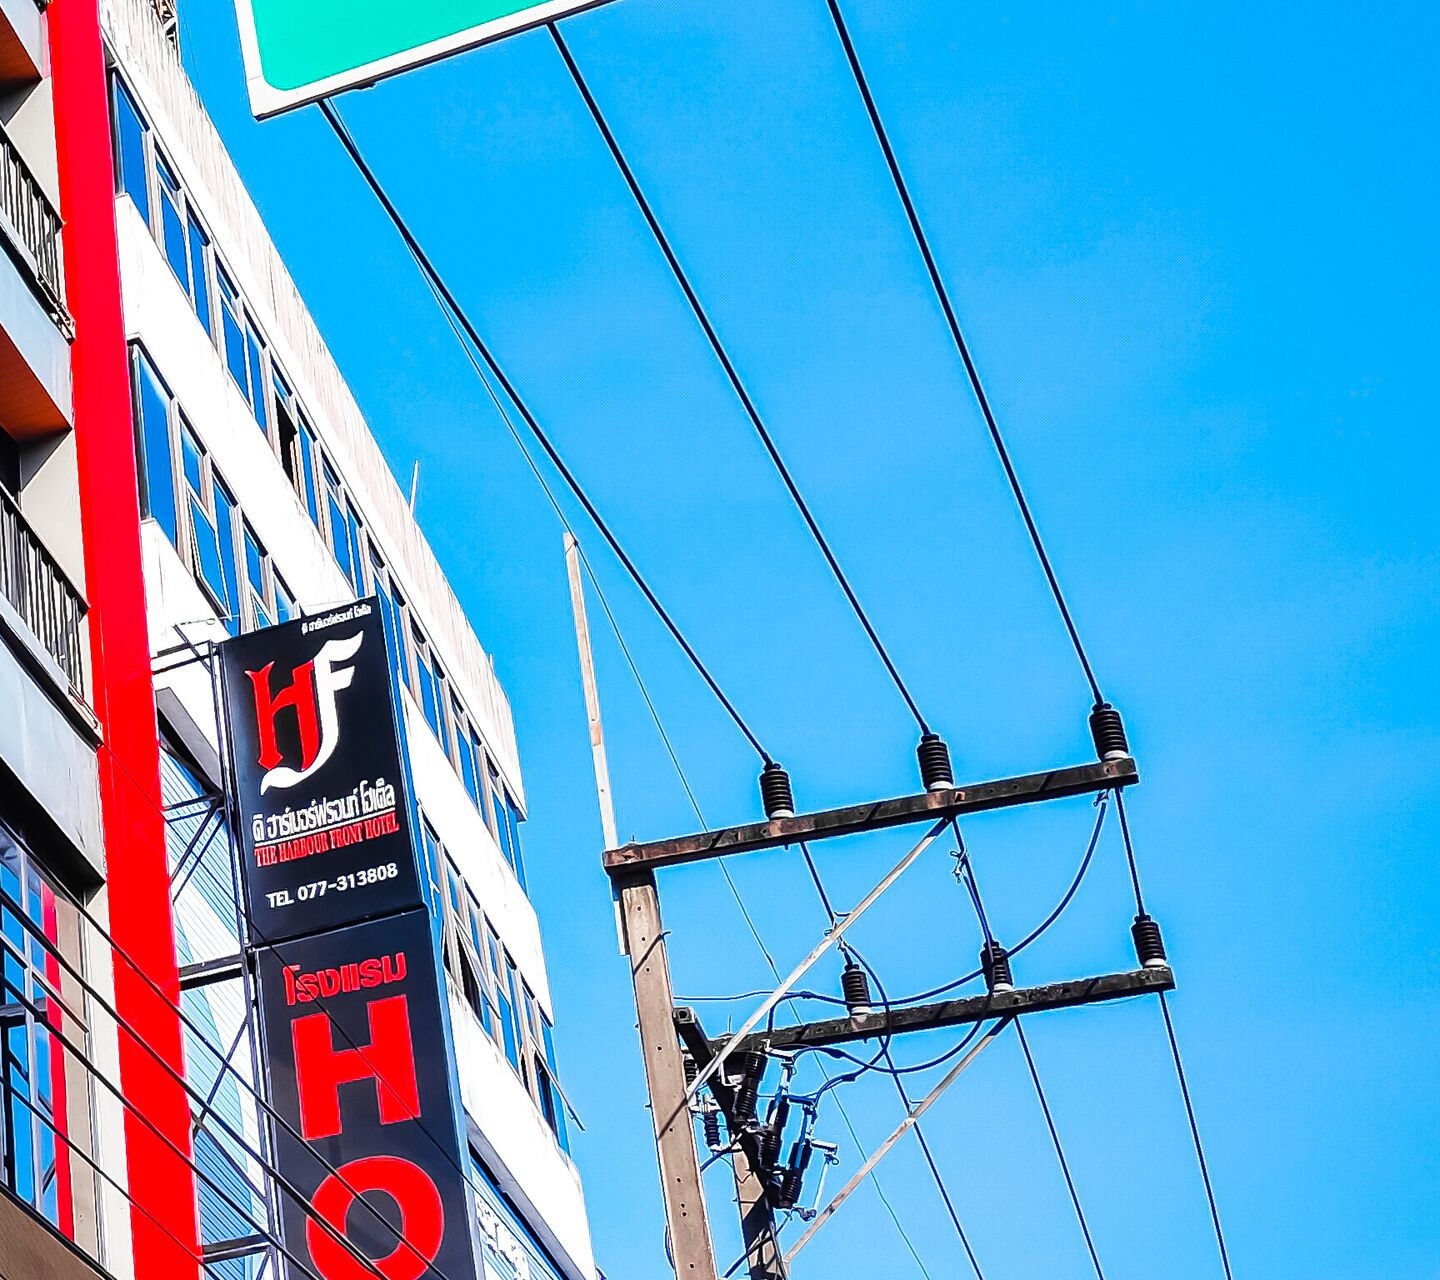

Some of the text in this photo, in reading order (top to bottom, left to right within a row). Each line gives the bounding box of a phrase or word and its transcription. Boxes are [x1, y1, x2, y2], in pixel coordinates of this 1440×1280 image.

[254, 812, 400, 868] THE HARBOUR FRONT HOTEL
[297, 862, 399, 902] 077-313808
[282, 951, 408, 1007] โรงแรม
